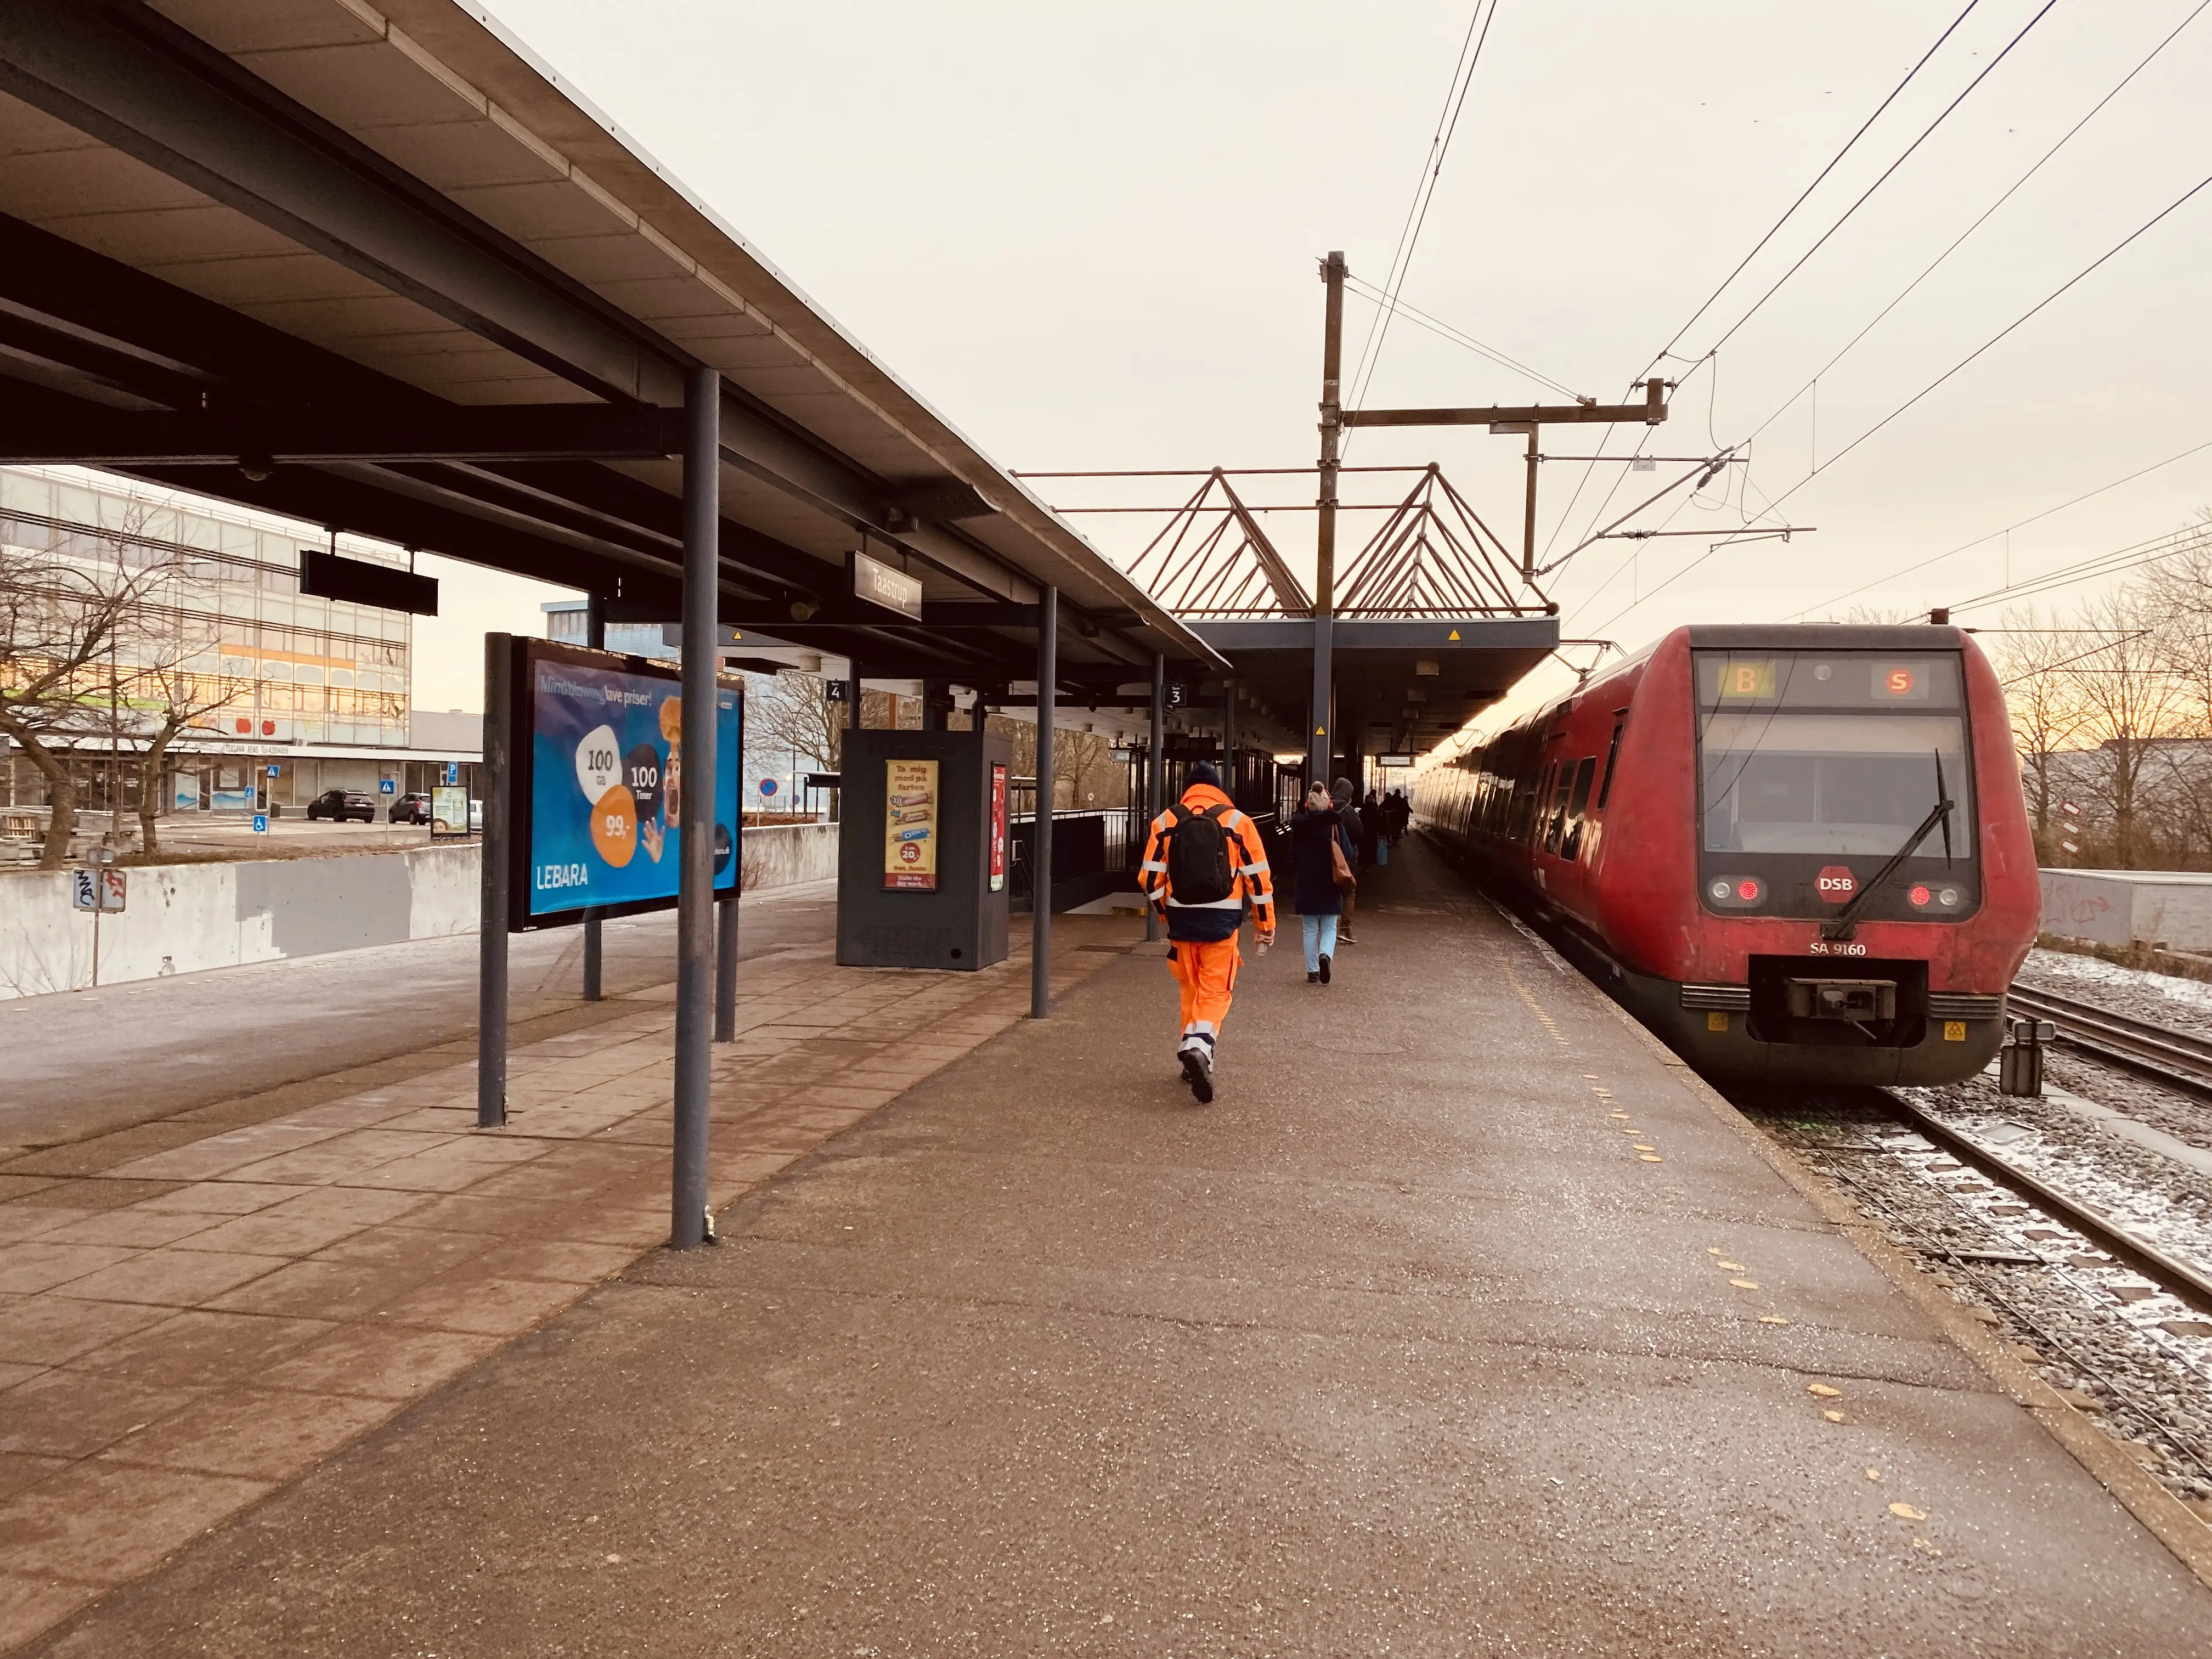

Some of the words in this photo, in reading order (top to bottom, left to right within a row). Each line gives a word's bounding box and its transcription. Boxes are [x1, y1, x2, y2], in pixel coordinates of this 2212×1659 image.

[873, 567, 907, 608] Taastrup
[1736, 668, 1756, 692] B
[1892, 673, 1908, 690] S
[605, 685, 622, 702] lave
[624, 689, 651, 708] priser!
[831, 687, 839, 698] 4
[1171, 691, 1180, 703] 3
[588, 750, 613, 771] 100
[449, 764, 456, 774] P
[910, 765, 927, 774] mig
[596, 775, 606, 786] GB
[631, 766, 657, 788] 100
[916, 774, 927, 783] på
[636, 790, 652, 800] Timer
[606, 815, 630, 839] 99,-
[537, 863, 588, 890] LEBARA
[1820, 877, 1853, 891] DSB
[1810, 943, 1829, 955] SA
[1833, 944, 1866, 956] 9160
